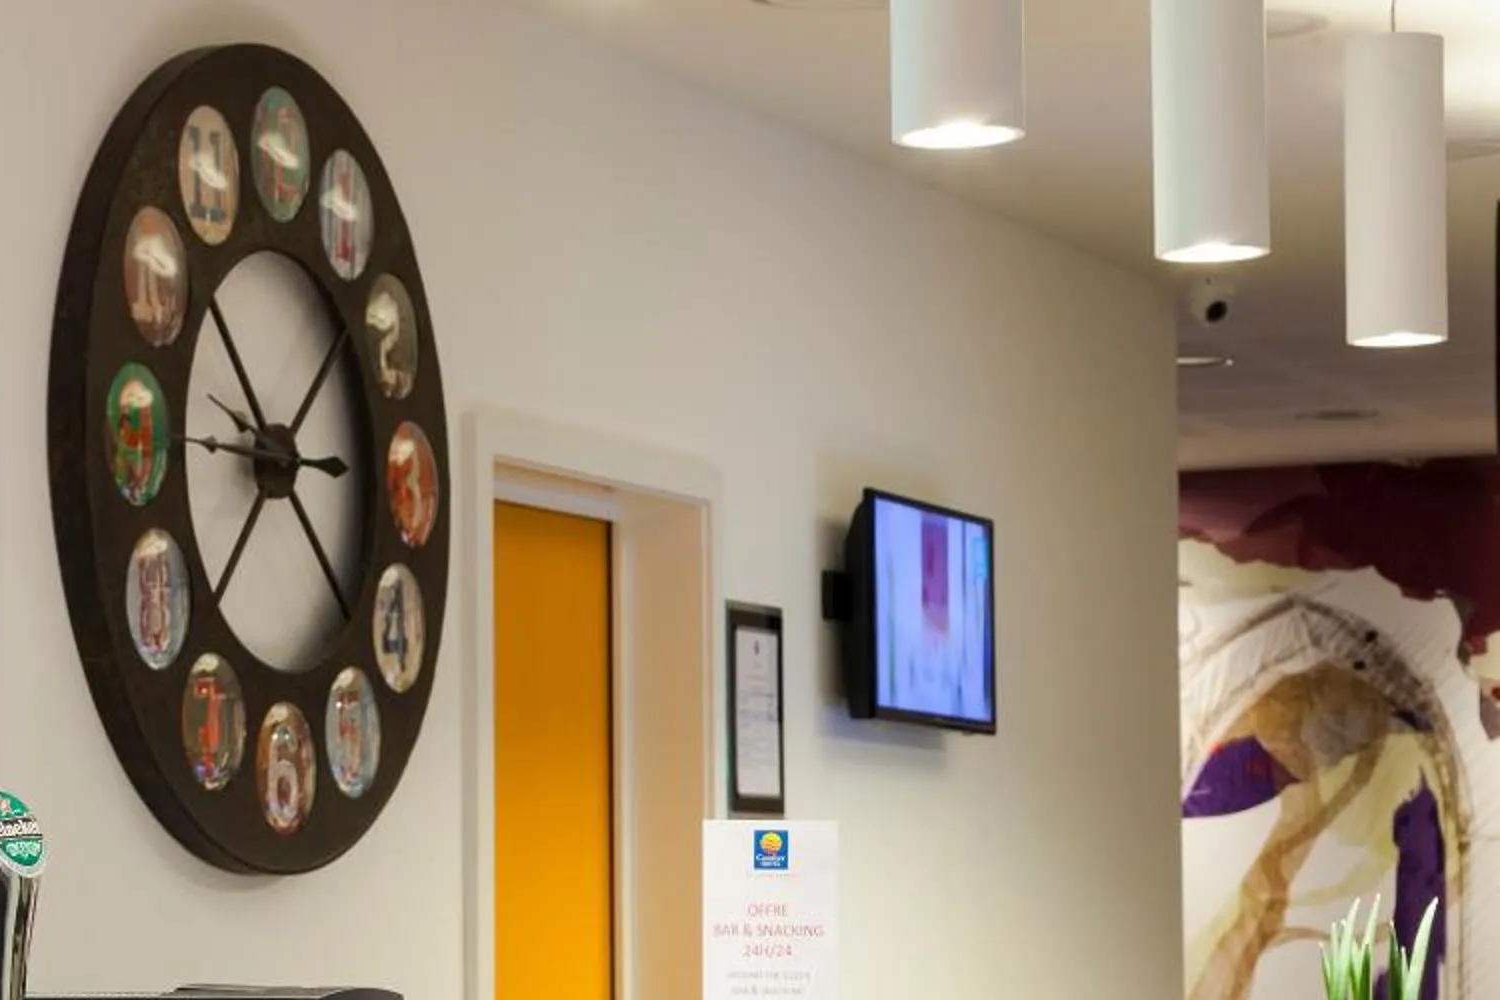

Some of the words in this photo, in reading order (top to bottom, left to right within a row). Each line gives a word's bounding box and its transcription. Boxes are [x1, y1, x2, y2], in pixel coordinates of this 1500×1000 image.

[747, 904, 789, 917] OFFRE
[713, 924, 739, 937] BAR
[743, 925, 753, 937] &
[756, 924, 825, 938] SNACKING
[742, 945, 793, 958] 24H/24
